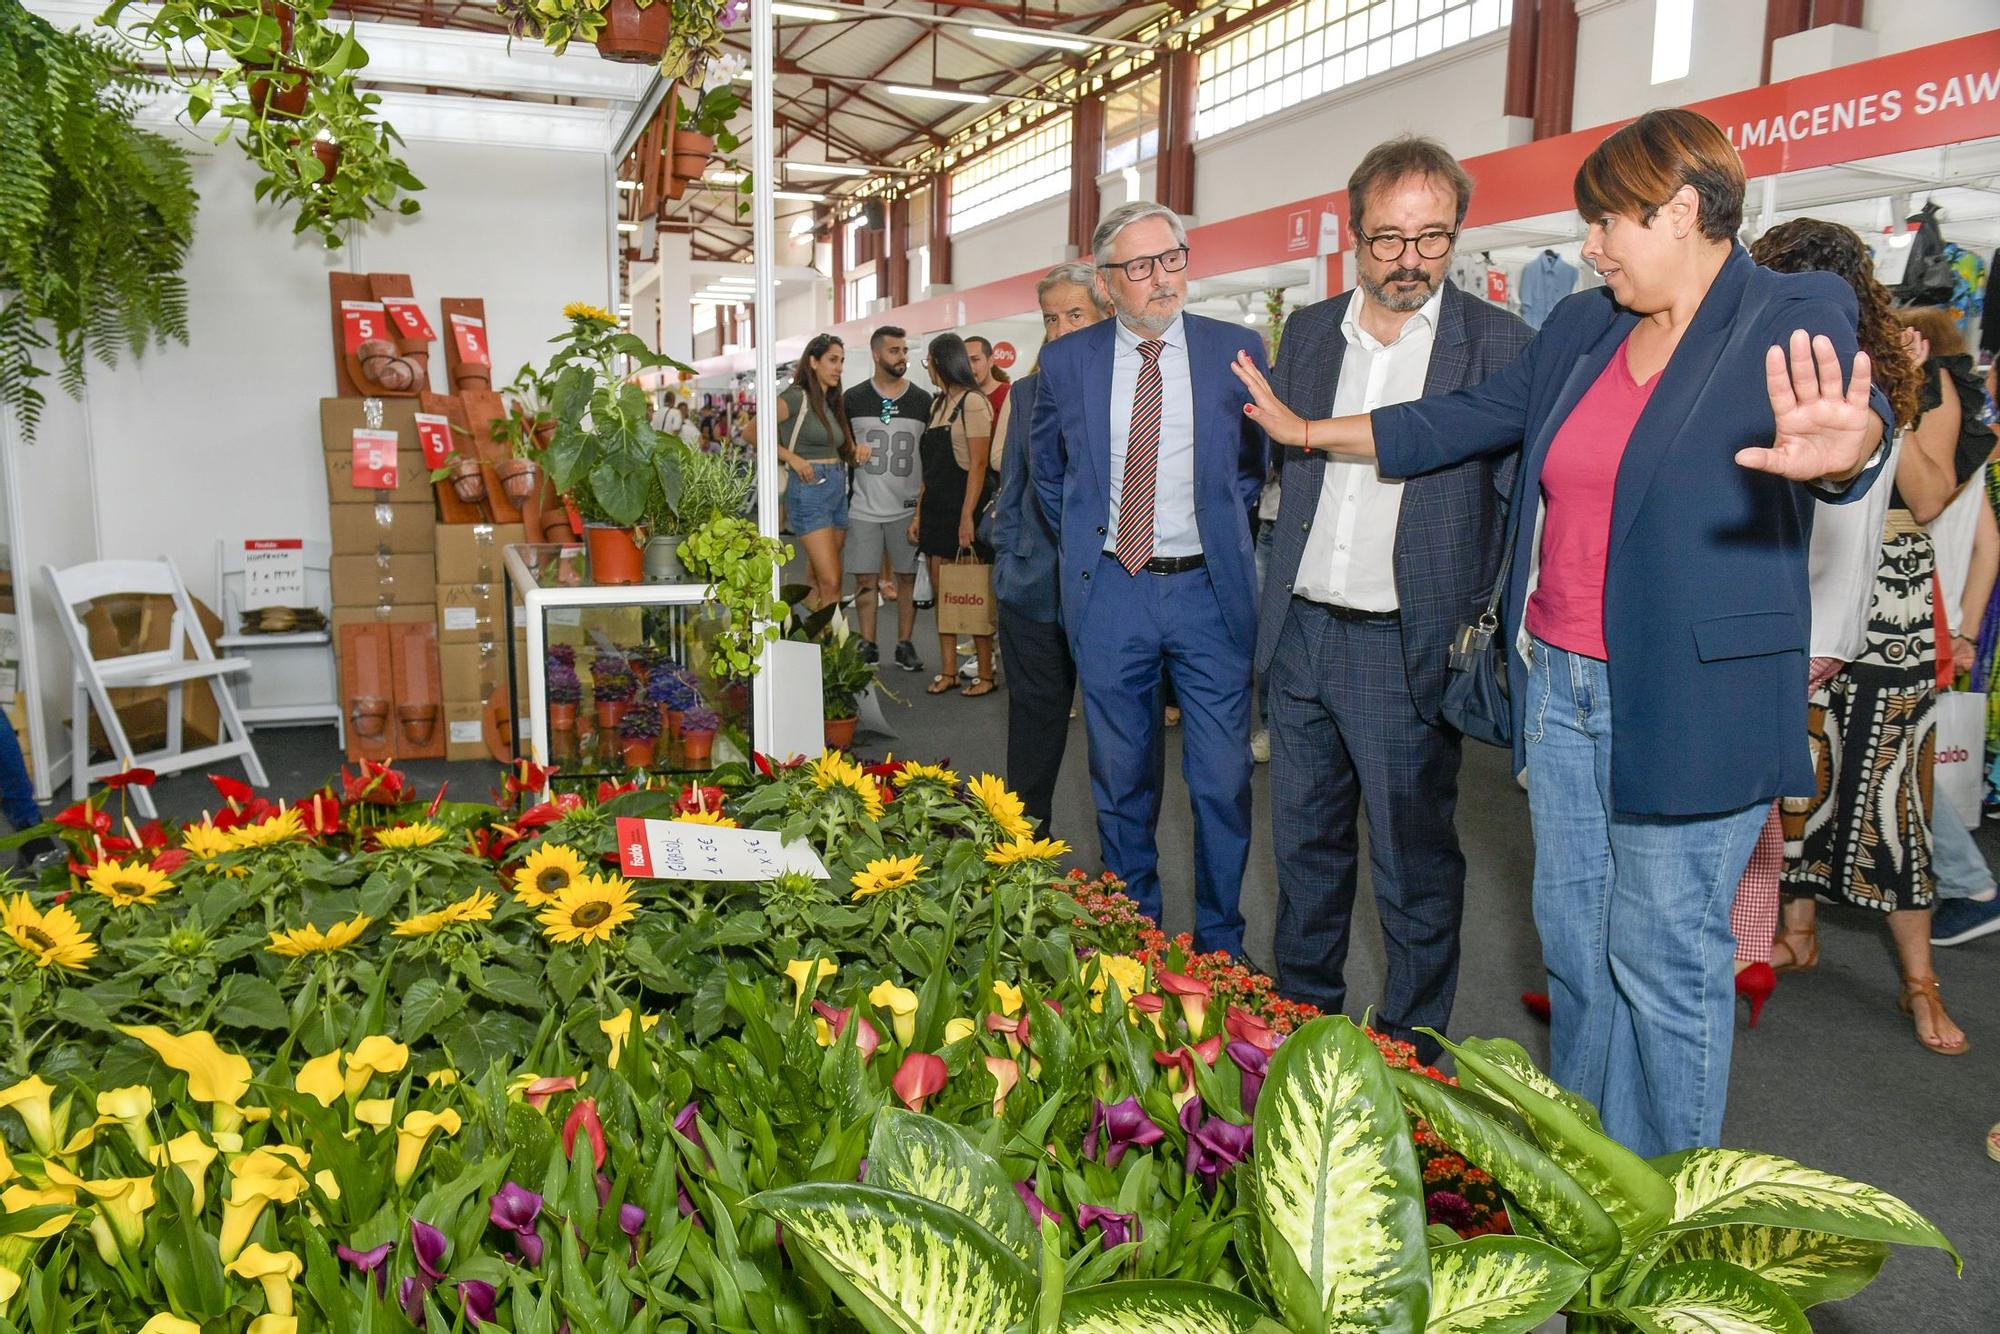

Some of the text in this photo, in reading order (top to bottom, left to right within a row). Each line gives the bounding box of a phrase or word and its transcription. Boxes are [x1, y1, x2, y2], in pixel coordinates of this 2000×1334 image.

[1725, 69, 2000, 152] LMACENES SAW
[359, 319, 373, 338] 5
[403, 311, 418, 327] 5
[466, 333, 479, 352] 5
[431, 432, 444, 453] 5
[864, 429, 915, 477] 38
[368, 449, 383, 470] 5
[944, 592, 984, 605] fisaldo
[628, 843, 645, 867] fisaldo
